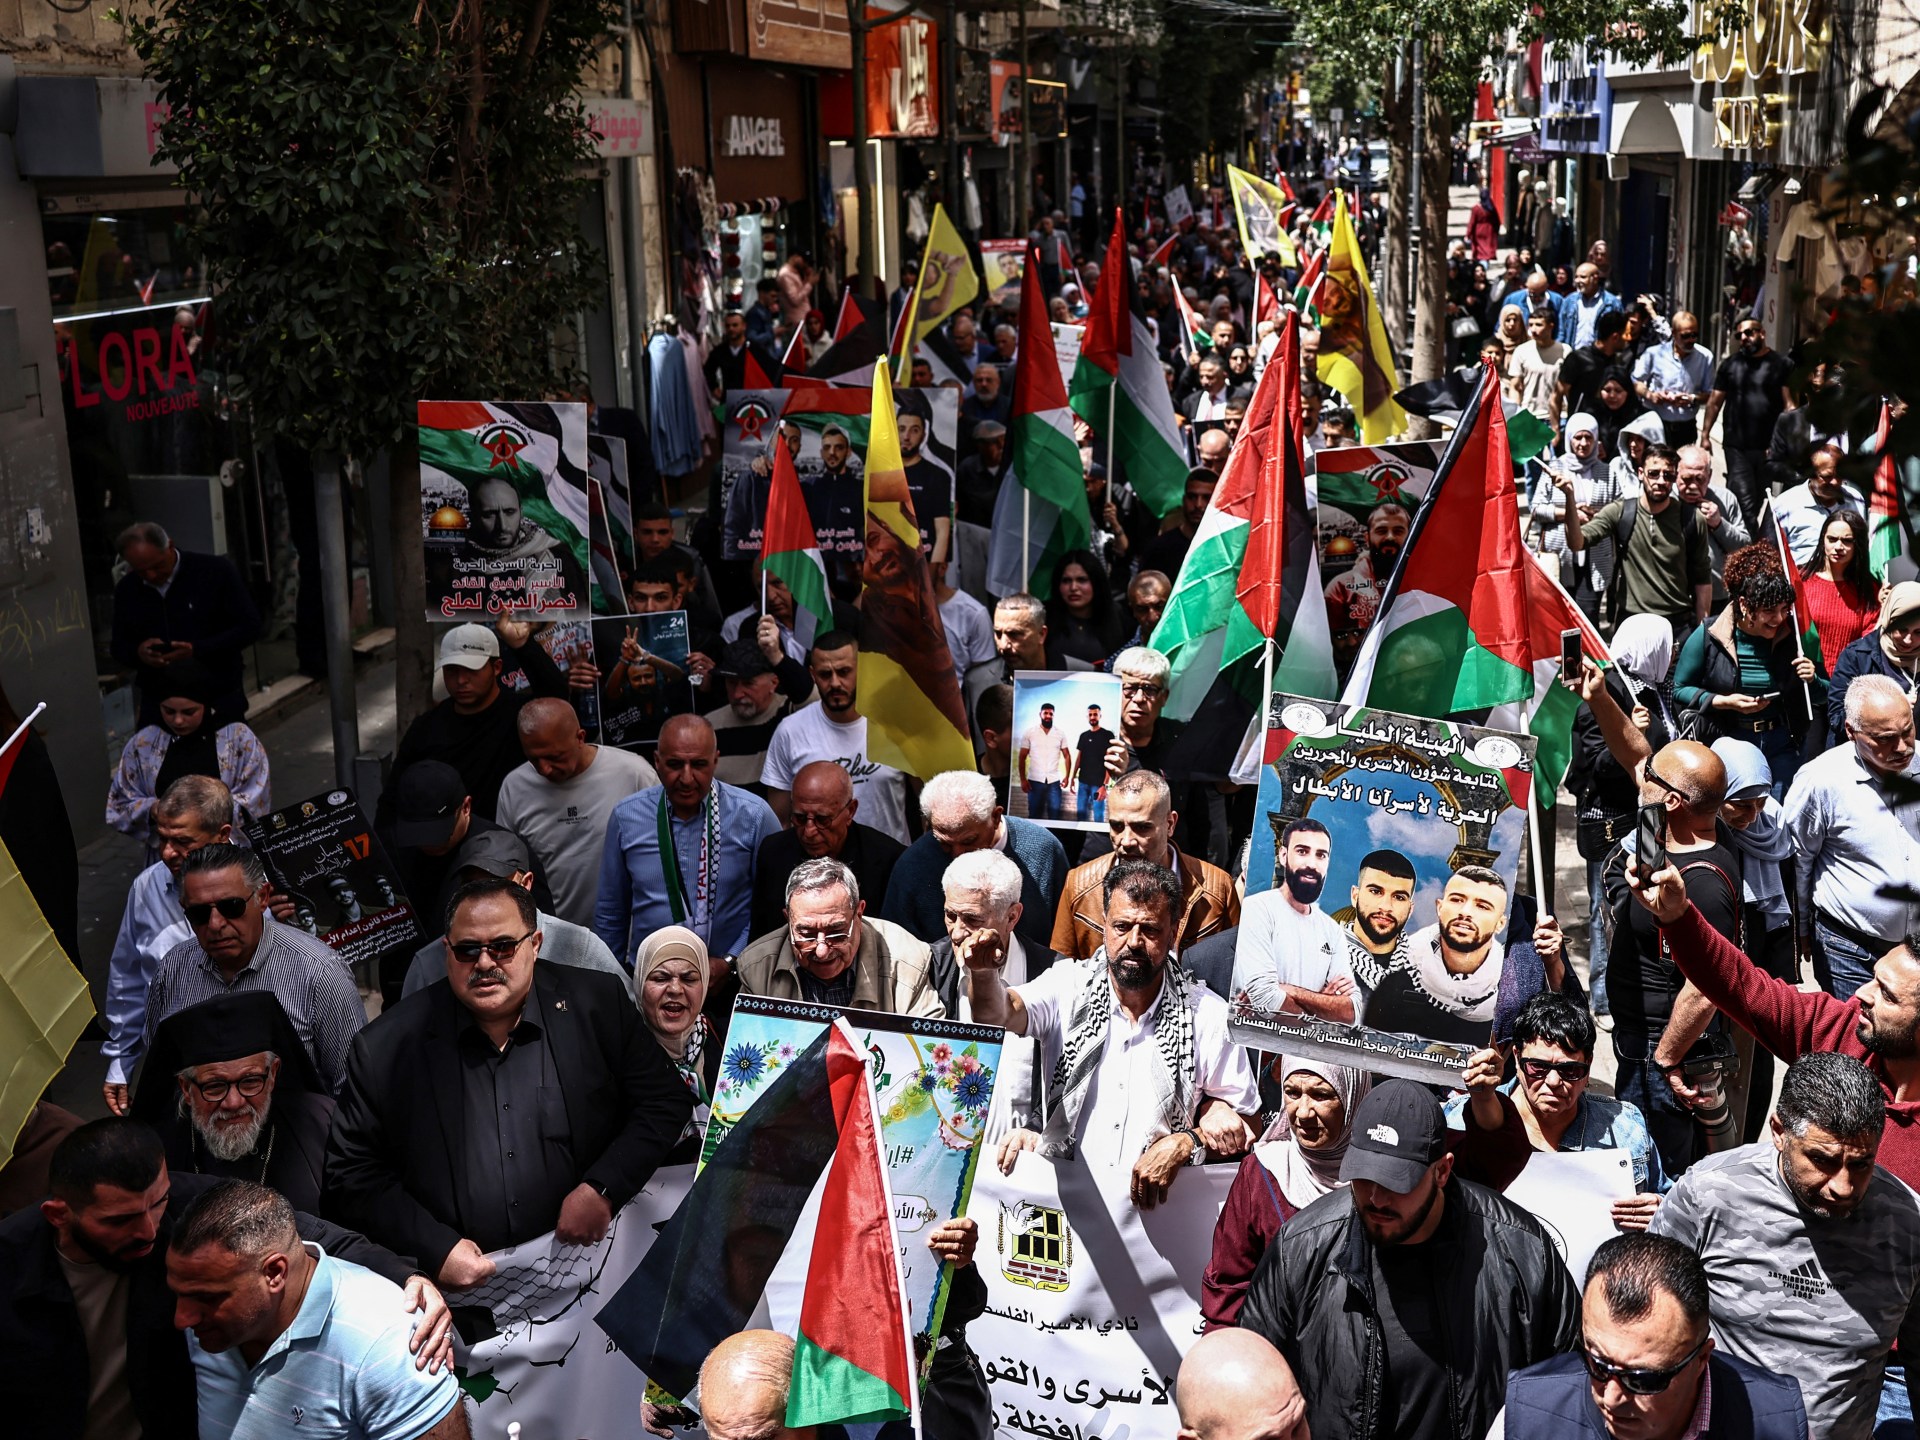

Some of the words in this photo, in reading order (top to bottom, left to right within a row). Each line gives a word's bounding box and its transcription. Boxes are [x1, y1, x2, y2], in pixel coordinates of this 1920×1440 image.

[1713, 95, 1770, 149] KIDS
[728, 115, 785, 156] ANGEL
[453, 558, 487, 571] الحرية
[530, 558, 563, 571] الحرية
[489, 576, 526, 591] الرفيق
[669, 617, 685, 628] 24
[1403, 725, 1467, 758] الهيئة
[1293, 742, 1357, 771] والمحررين
[1358, 754, 1411, 776] الأسرى
[1411, 761, 1452, 784] شؤون
[1452, 768, 1501, 790] لمتابعة
[1292, 775, 1364, 803] الأبطال
[1437, 800, 1499, 827] الحرية
[344, 833, 369, 861] 17
[341, 924, 362, 941] إعدام
[362, 916, 381, 931] قانون
[1233, 1011, 1279, 1032] النعسان
[1278, 1022, 1309, 1039] باسم
[1315, 1029, 1362, 1049] النعسان
[1362, 1040, 1389, 1055] ماجد
[1397, 1047, 1444, 1067] النعسان
[1036, 1312, 1093, 1335] الأسير
[1097, 1316, 1139, 1337] نادي
[984, 1355, 1057, 1401] والقو
